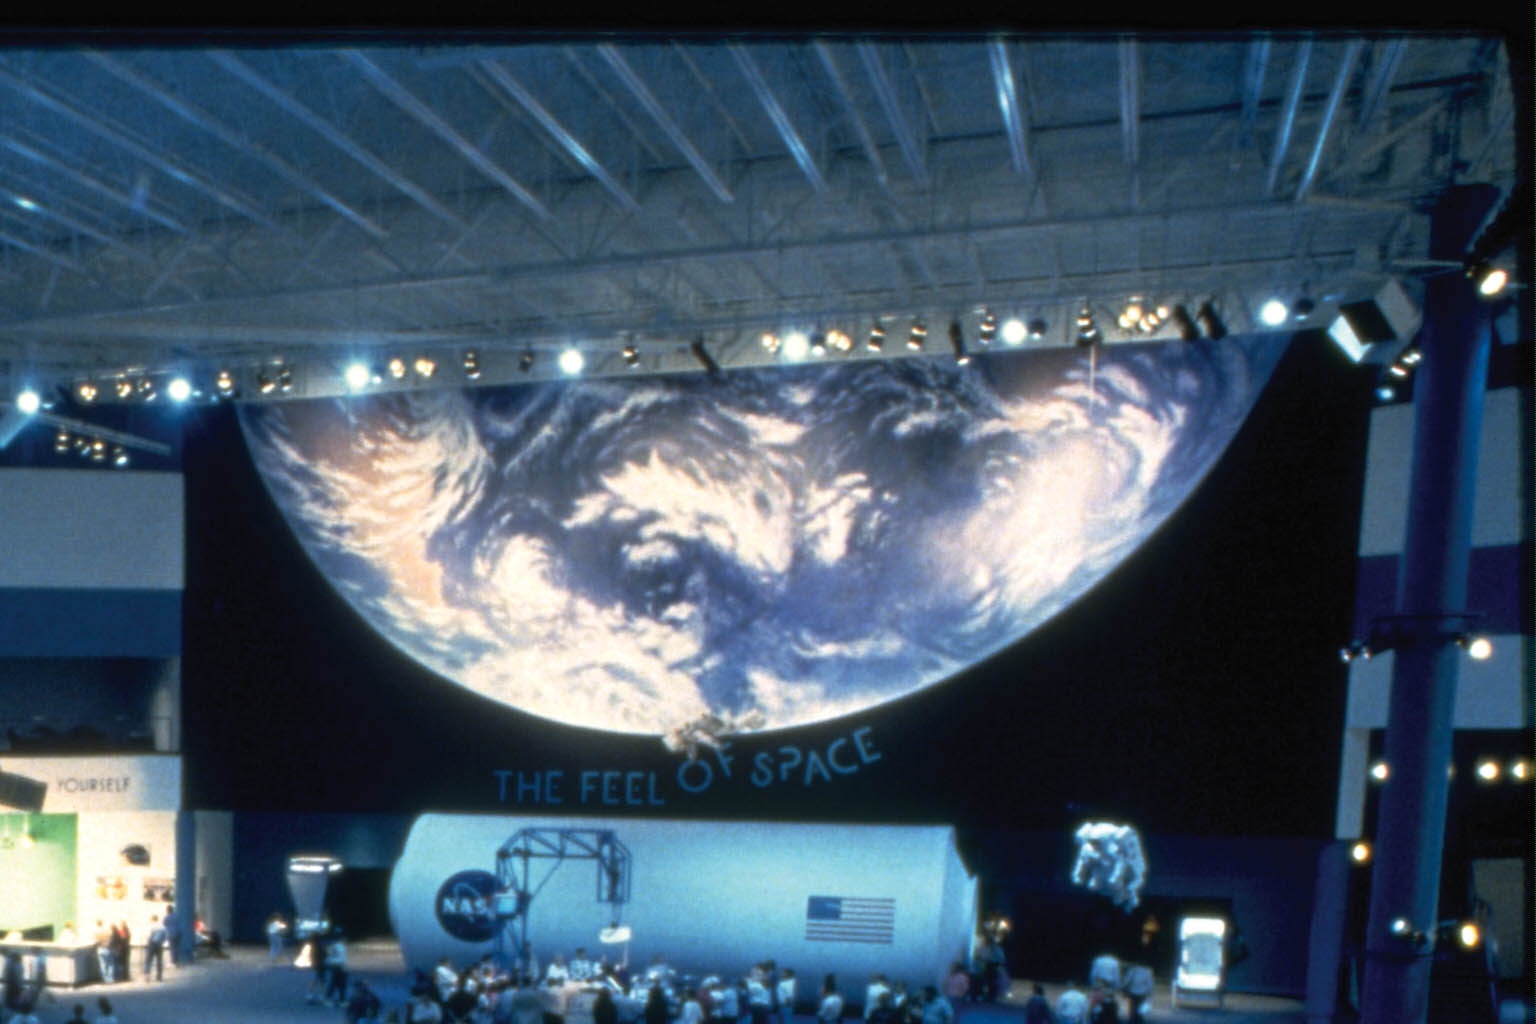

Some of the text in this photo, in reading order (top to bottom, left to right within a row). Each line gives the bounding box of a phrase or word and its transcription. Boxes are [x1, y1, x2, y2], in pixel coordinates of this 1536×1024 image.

[55, 777, 132, 794] YOURSELF
[493, 727, 882, 805] THE FEEL OF SPACE
